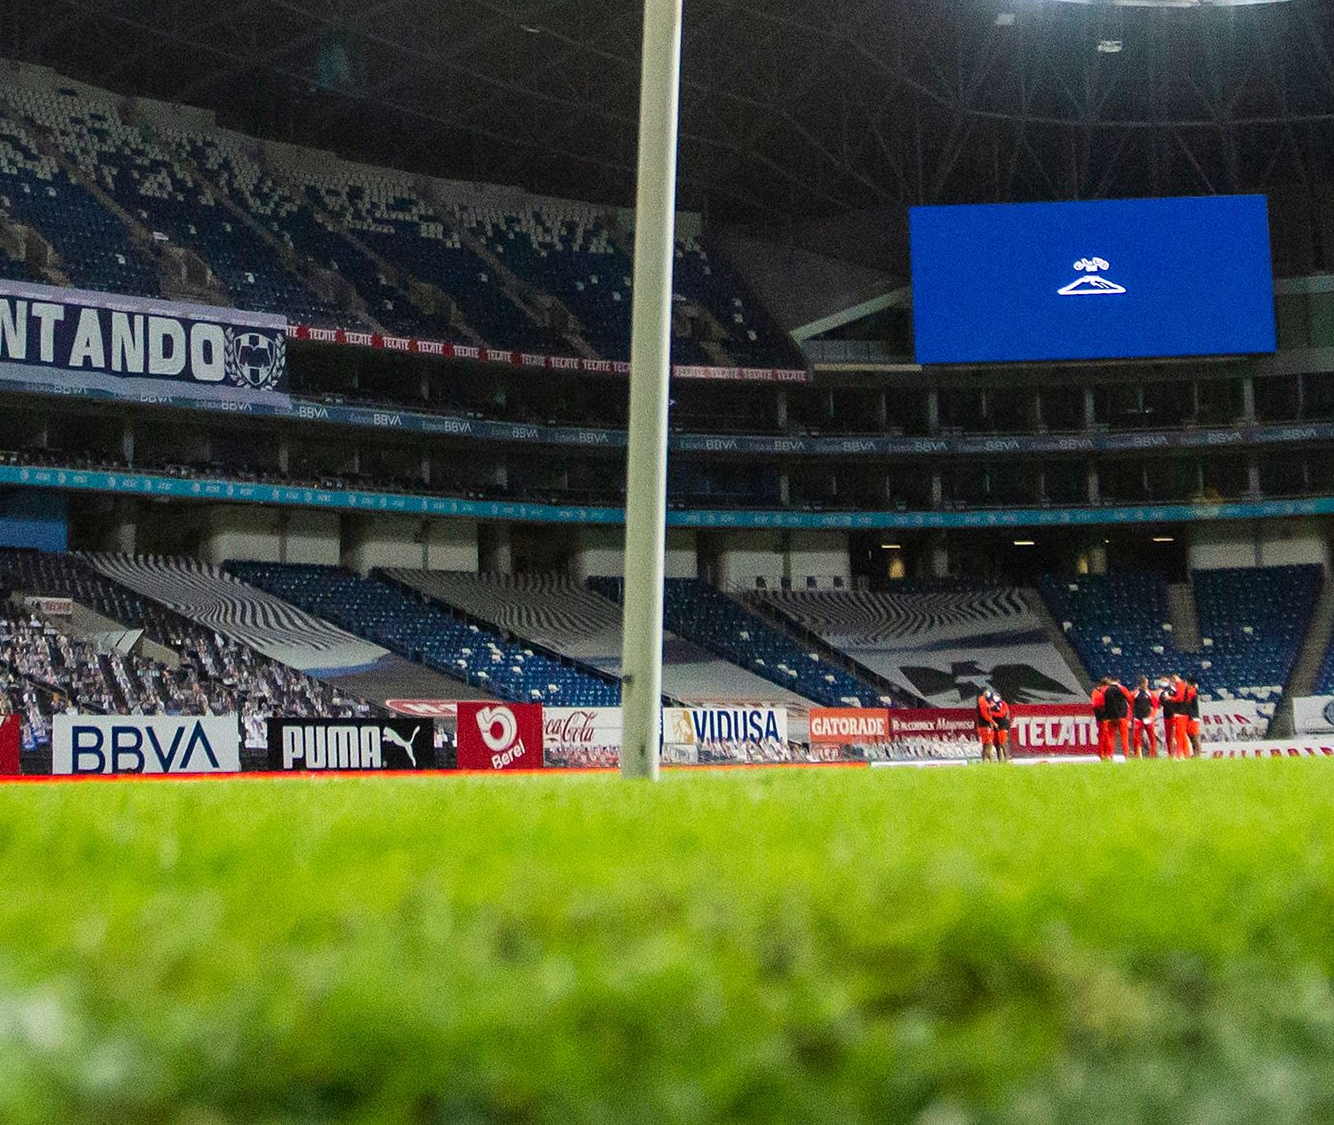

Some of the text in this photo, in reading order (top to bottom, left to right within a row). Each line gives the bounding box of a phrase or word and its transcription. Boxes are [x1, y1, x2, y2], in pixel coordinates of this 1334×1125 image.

[221, 399, 253, 412] BBVA
[298, 406, 329, 419] BBVA
[373, 414, 402, 426] BBVA
[444, 421, 471, 433] BBVA
[512, 427, 539, 439] BBVA
[579, 432, 608, 444] BBVA
[706, 440, 738, 450] BBVA
[774, 441, 805, 451] BBVA
[843, 441, 876, 452] BBVA
[915, 442, 947, 452] BBVA
[986, 440, 1019, 451] BBVA
[1060, 439, 1093, 450] BBVA
[692, 710, 780, 743] VIDUSA
[812, 718, 884, 736] GATORADE
[71, 720, 220, 774] BBVA
[283, 726, 381, 769] PUMA
[491, 739, 525, 770] Berel
